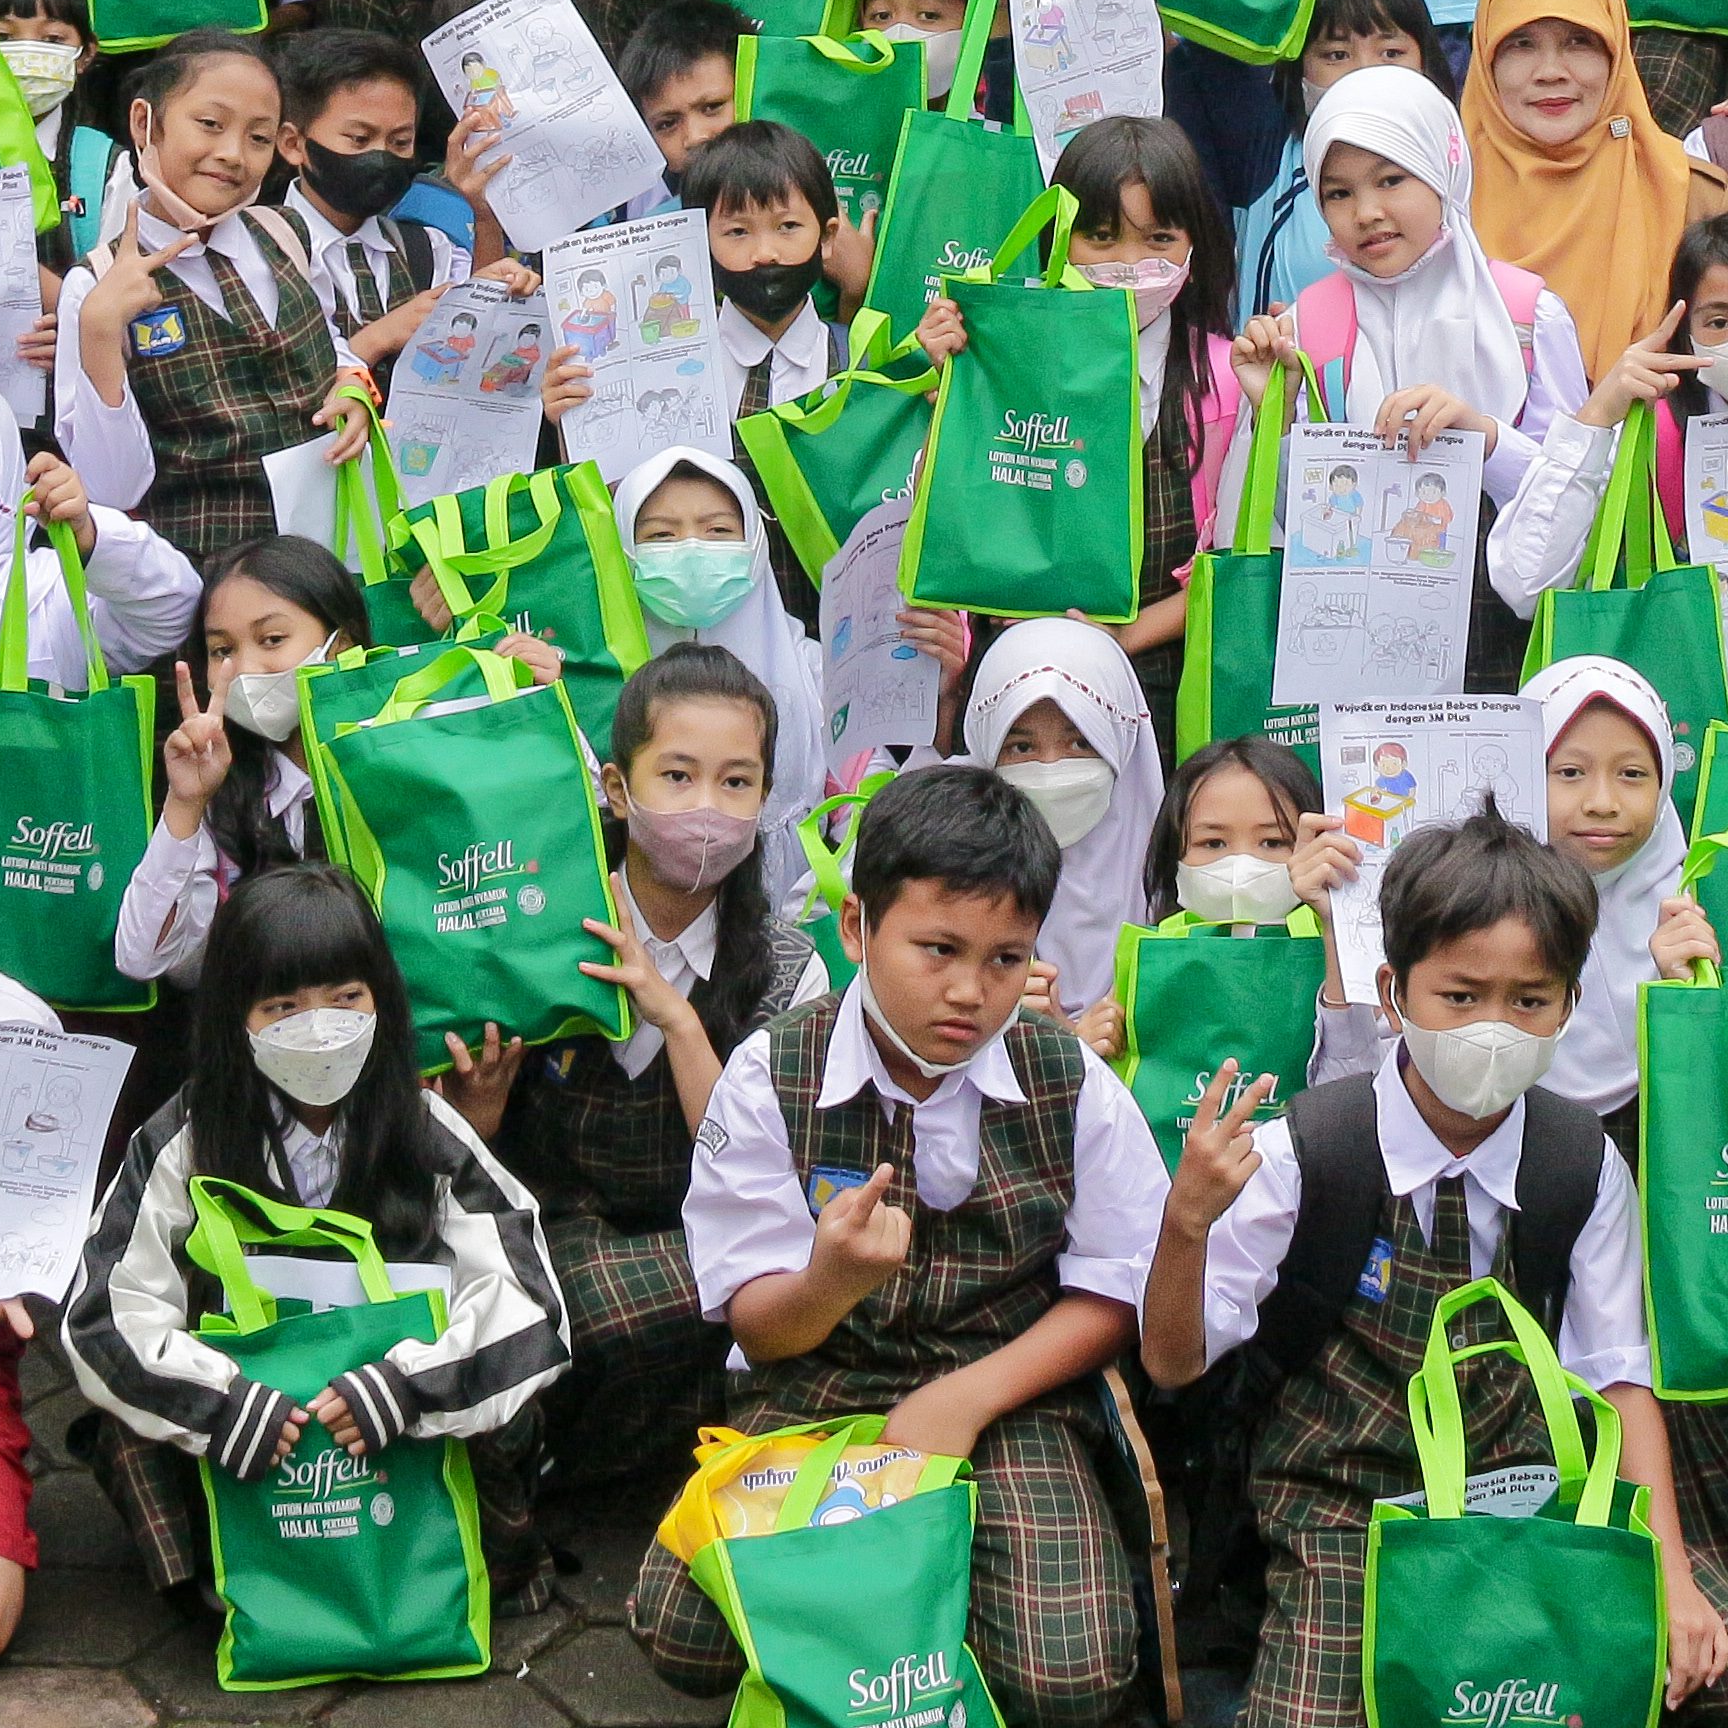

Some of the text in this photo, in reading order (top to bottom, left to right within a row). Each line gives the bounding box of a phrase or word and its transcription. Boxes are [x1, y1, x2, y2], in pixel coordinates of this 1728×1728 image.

[825, 148, 870, 178] ffell
[629, 222, 655, 236] Bebas
[1000, 409, 1070, 453] Soffell
[991, 465, 1027, 485] HALAL
[1334, 702, 1522, 715] Wujudkan Indonesia Bebas Dengue
[1385, 713, 1471, 725] dengan 3M Plus
[11, 815, 94, 860] Soffell
[438, 839, 517, 892] Soffell
[4, 870, 43, 890] HALAL
[433, 899, 461, 915] LOTION
[437, 912, 477, 933] HALAL
[35, 1039, 58, 1052] Plus
[278, 1448, 370, 1499] Soffell
[1509, 1471, 1545, 1483] Bebas
[1489, 1483, 1535, 1497] 3M Plus
[272, 1497, 362, 1518] LOTION ANTI NYAMUK
[279, 1515, 358, 1538] HALAL PERTAMA
[848, 1651, 952, 1716] Soffell
[1447, 1678, 1560, 1728] Soffell
[904, 1706, 945, 1728] NYAMUK
